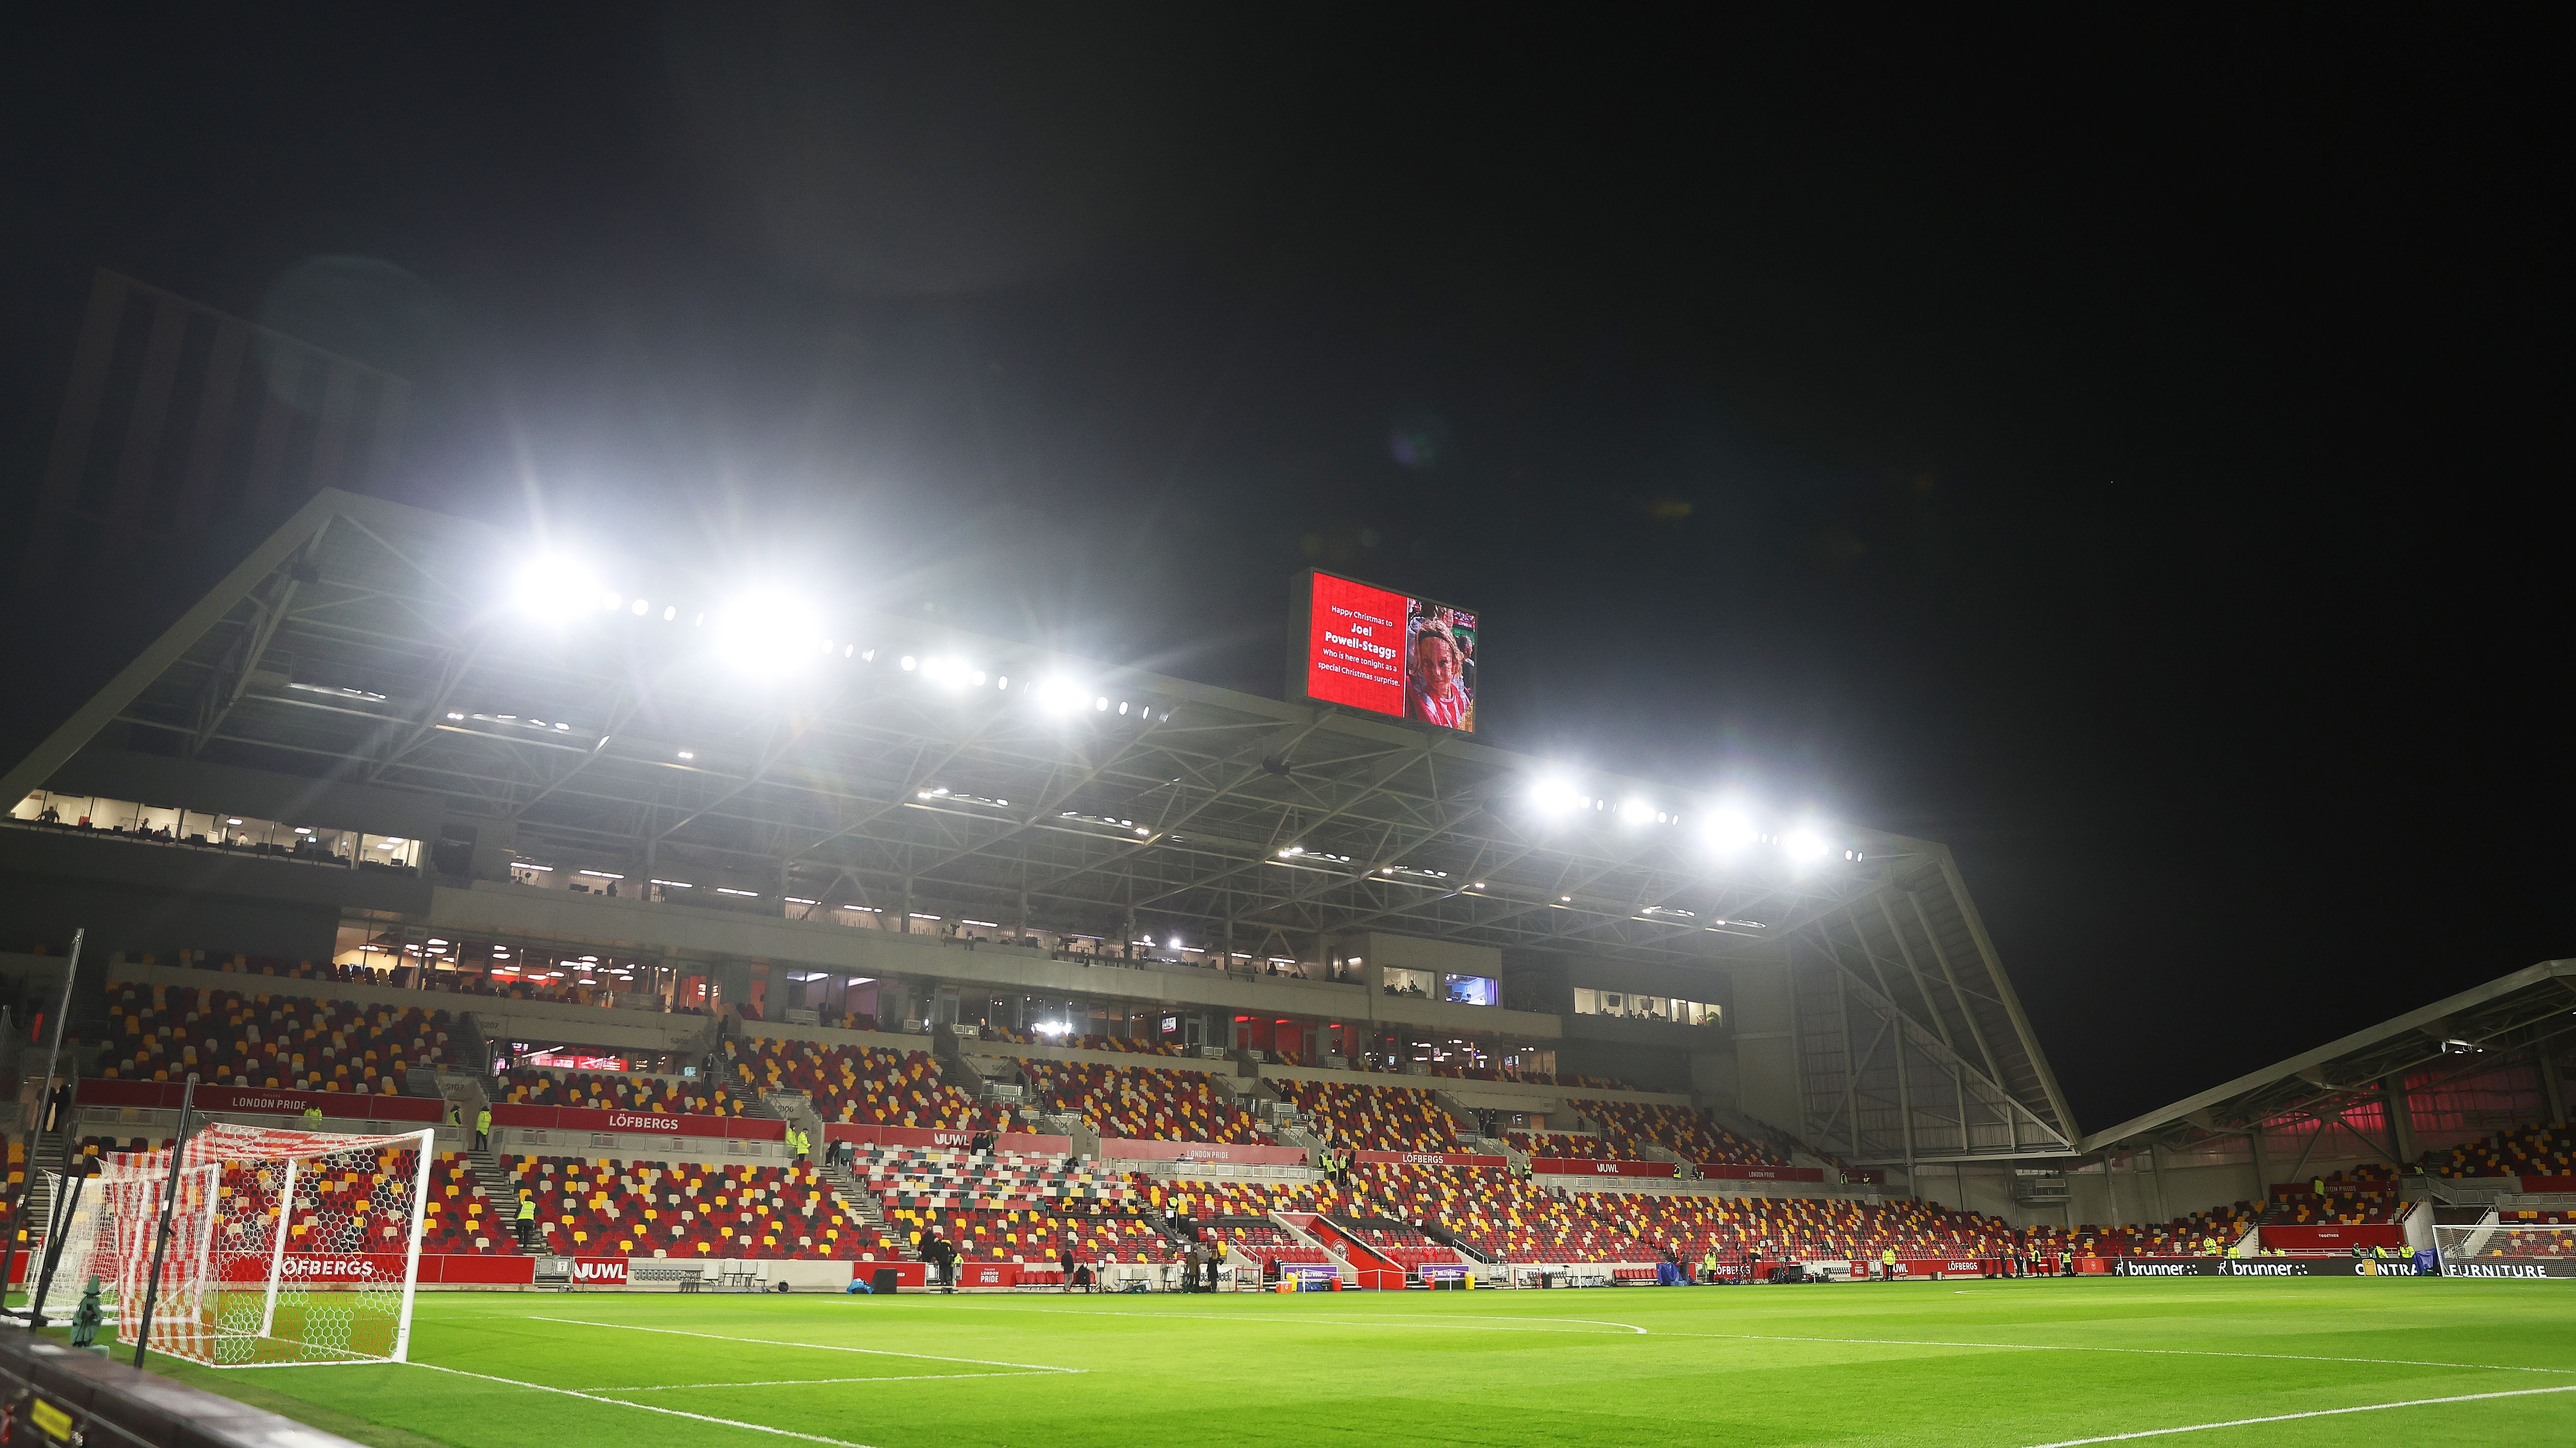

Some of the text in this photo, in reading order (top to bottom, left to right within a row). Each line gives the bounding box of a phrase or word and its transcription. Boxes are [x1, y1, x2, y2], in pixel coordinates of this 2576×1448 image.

[1331, 605, 1353, 618] Happy
[1353, 611, 1384, 625] Christmas
[1351, 623, 1372, 637] Joel
[1325, 631, 1396, 659] Powell-Staggs
[1323, 648, 1337, 657] Who
[1339, 651, 1344, 659] is
[1345, 653, 1360, 663] here
[1361, 658, 1384, 669] tonight
[1318, 662, 1400, 686] special Christmas surprise.
[233, 1097, 307, 1110] LONDON PRIDE
[609, 1113, 678, 1130] LÖFBERGS
[1187, 1150, 1210, 1158] LONDON
[1403, 1153, 1443, 1164] LÖFBERGS
[280, 1255, 373, 1275] ÖFBERGS
[1948, 1261, 1978, 1270] LÖFBERGS
[2128, 1261, 2184, 1276] brunner
[2232, 1260, 2292, 1276] brunner
[2449, 1264, 2547, 1277] FURNITURE
